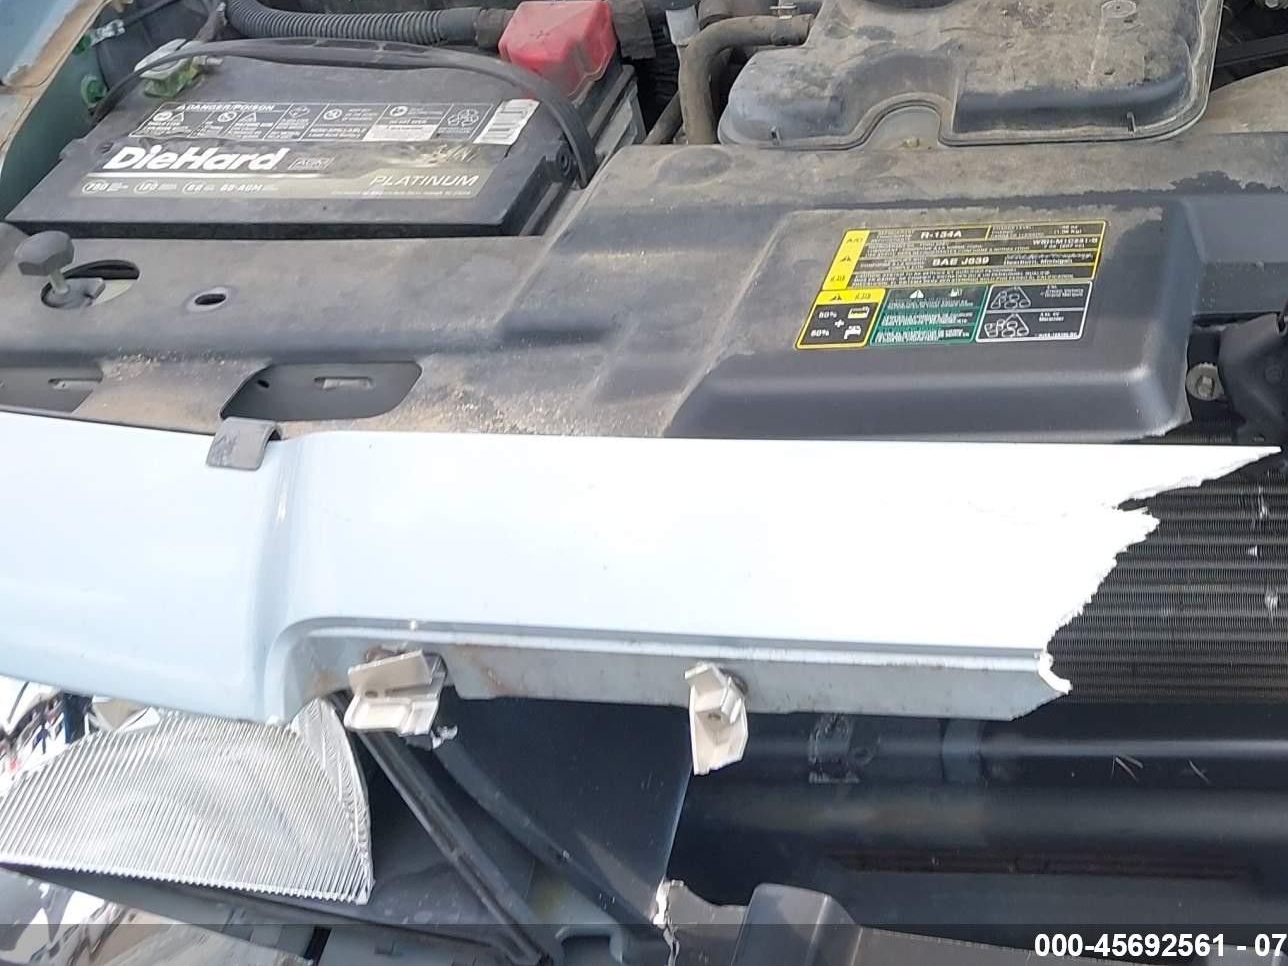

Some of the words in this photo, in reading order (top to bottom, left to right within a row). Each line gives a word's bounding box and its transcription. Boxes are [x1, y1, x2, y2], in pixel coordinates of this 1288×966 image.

[102, 144, 290, 172] DieHard
[370, 175, 480, 187] PLATINUM
[920, 229, 963, 239] R-134A
